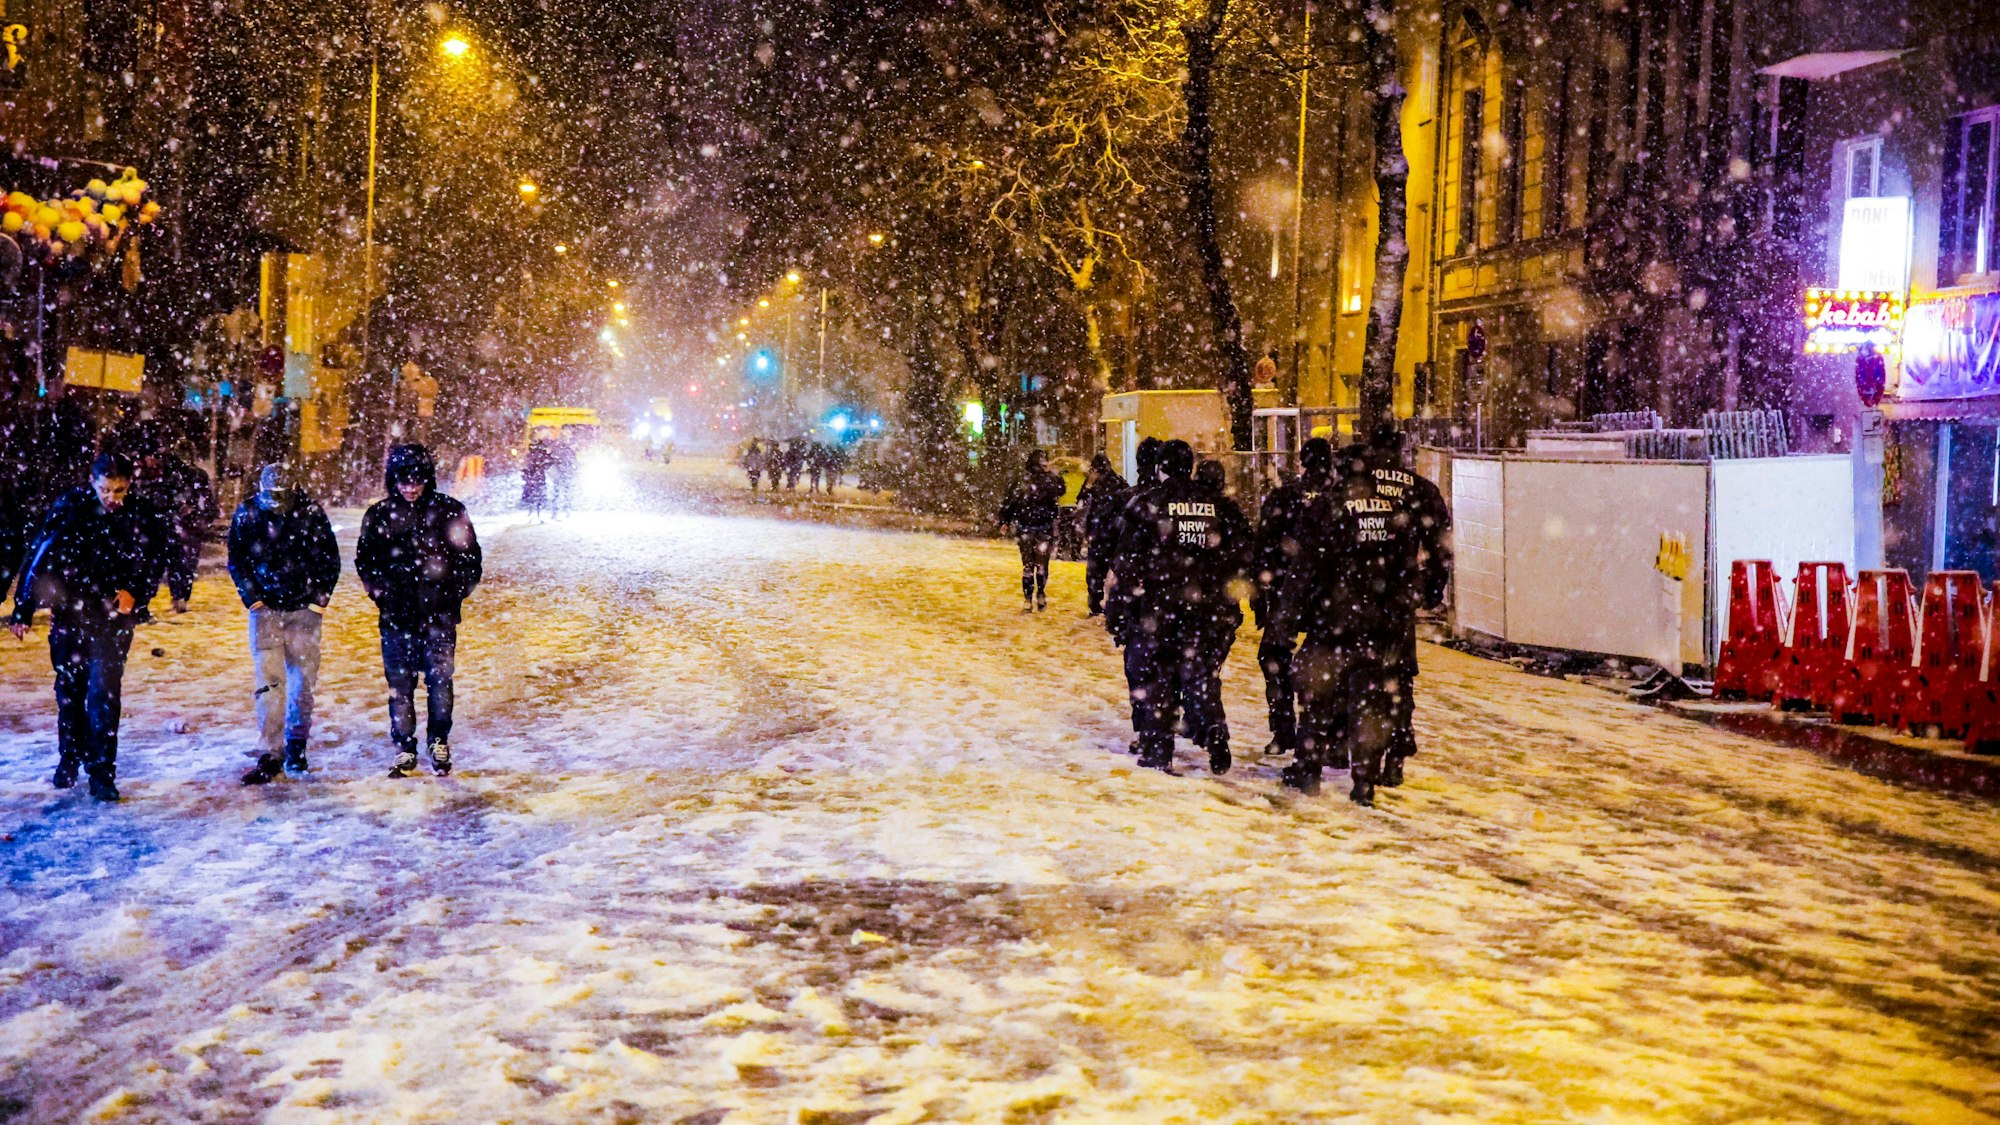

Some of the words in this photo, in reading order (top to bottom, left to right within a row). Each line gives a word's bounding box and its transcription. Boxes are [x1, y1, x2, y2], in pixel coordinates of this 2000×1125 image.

[1816, 301, 1890, 326] kebab
[1376, 484, 1404, 497] NRW
[1168, 502, 1216, 517] POLIZEI
[1344, 498, 1393, 514] POLIZEI
[1178, 520, 1206, 532] NRW
[1358, 517, 1386, 530] NRW
[1178, 531, 1206, 545] 31411
[1359, 530, 1388, 541] 31412
